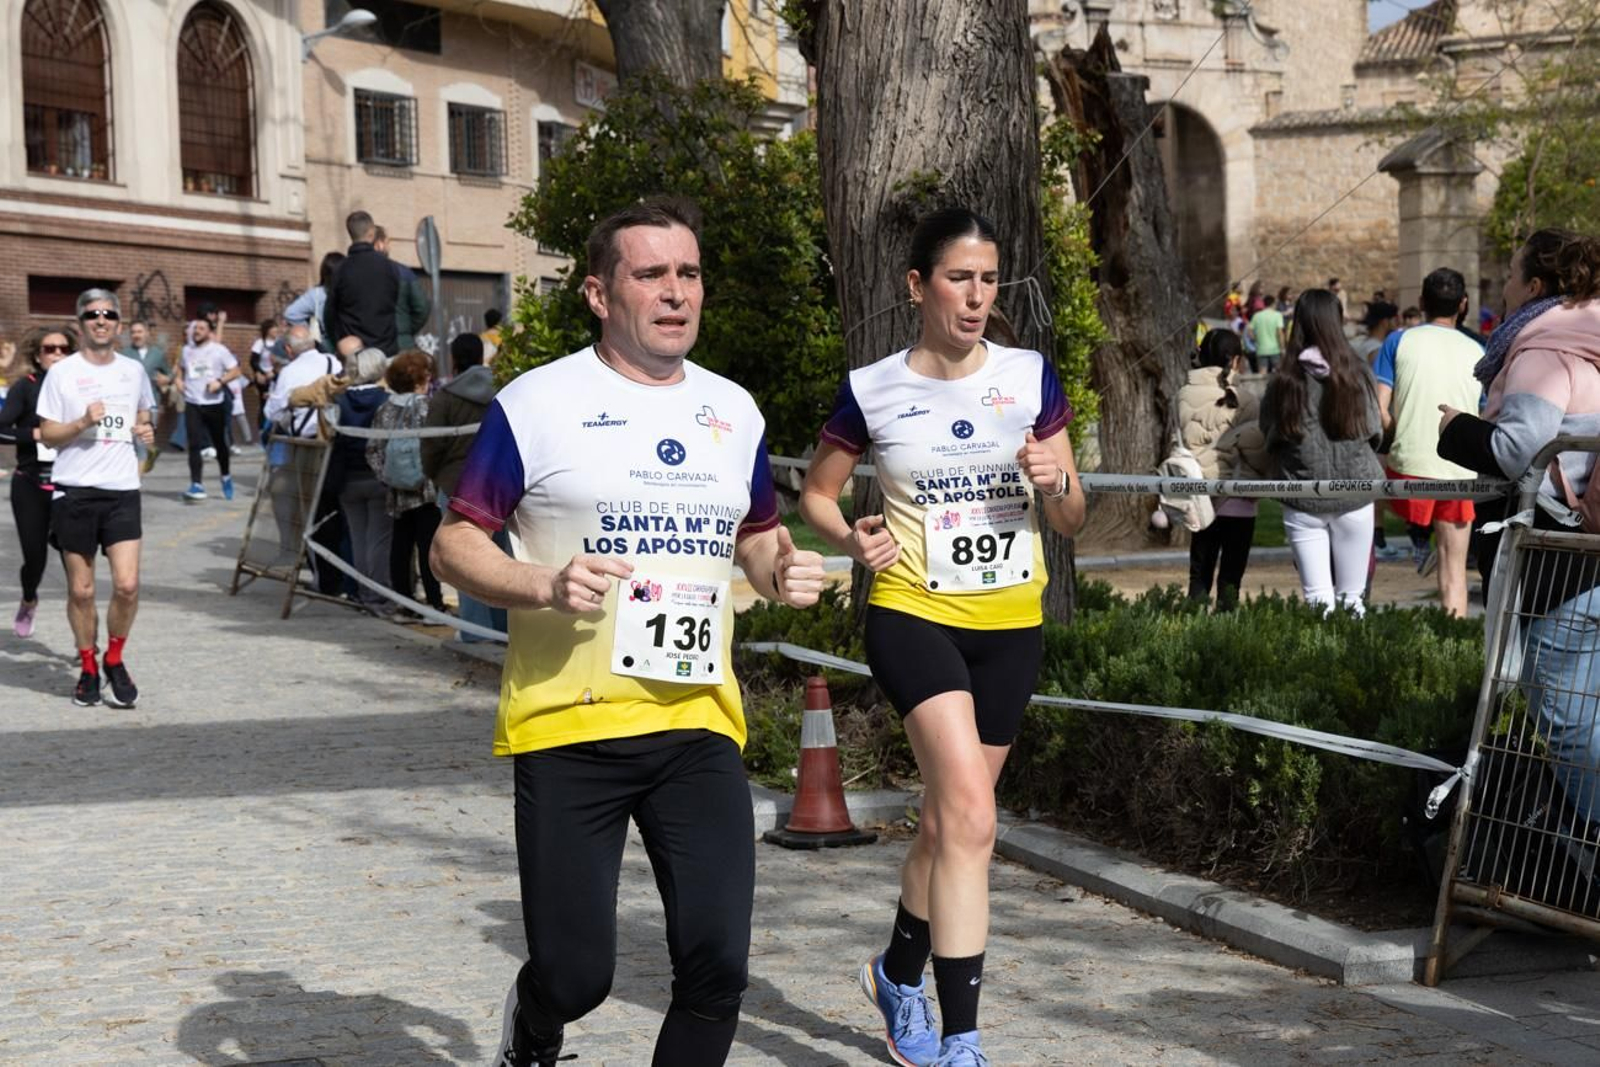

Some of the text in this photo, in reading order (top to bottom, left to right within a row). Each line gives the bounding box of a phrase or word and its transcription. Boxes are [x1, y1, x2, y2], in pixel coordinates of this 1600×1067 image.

[97, 415, 125, 429] 09
[582, 419, 628, 429] TEAMERGY
[931, 444, 957, 453] PABLO
[960, 440, 1001, 451] CARVAJAL
[629, 469, 719, 483] PABLO CARVAJAL
[910, 467, 944, 480] CLUB
[948, 465, 965, 477] DE
[915, 471, 1020, 492] SANTA Mª DE
[1170, 482, 1207, 493] DEPORTES
[1233, 482, 1275, 494] Ayuntamiento
[1276, 482, 1285, 492] de
[1328, 480, 1372, 491] DEPORTES
[1403, 480, 1456, 494] Ayuntamiento
[1459, 480, 1469, 492] de
[1471, 480, 1490, 492] Jaén
[909, 486, 1028, 506] OS APÓSTOLE
[596, 501, 742, 520] CLUB DE RUNNING
[601, 515, 735, 537] SANTA Mª DE
[583, 537, 628, 554] LOS
[951, 531, 1016, 566] 897
[645, 613, 711, 652] 136
